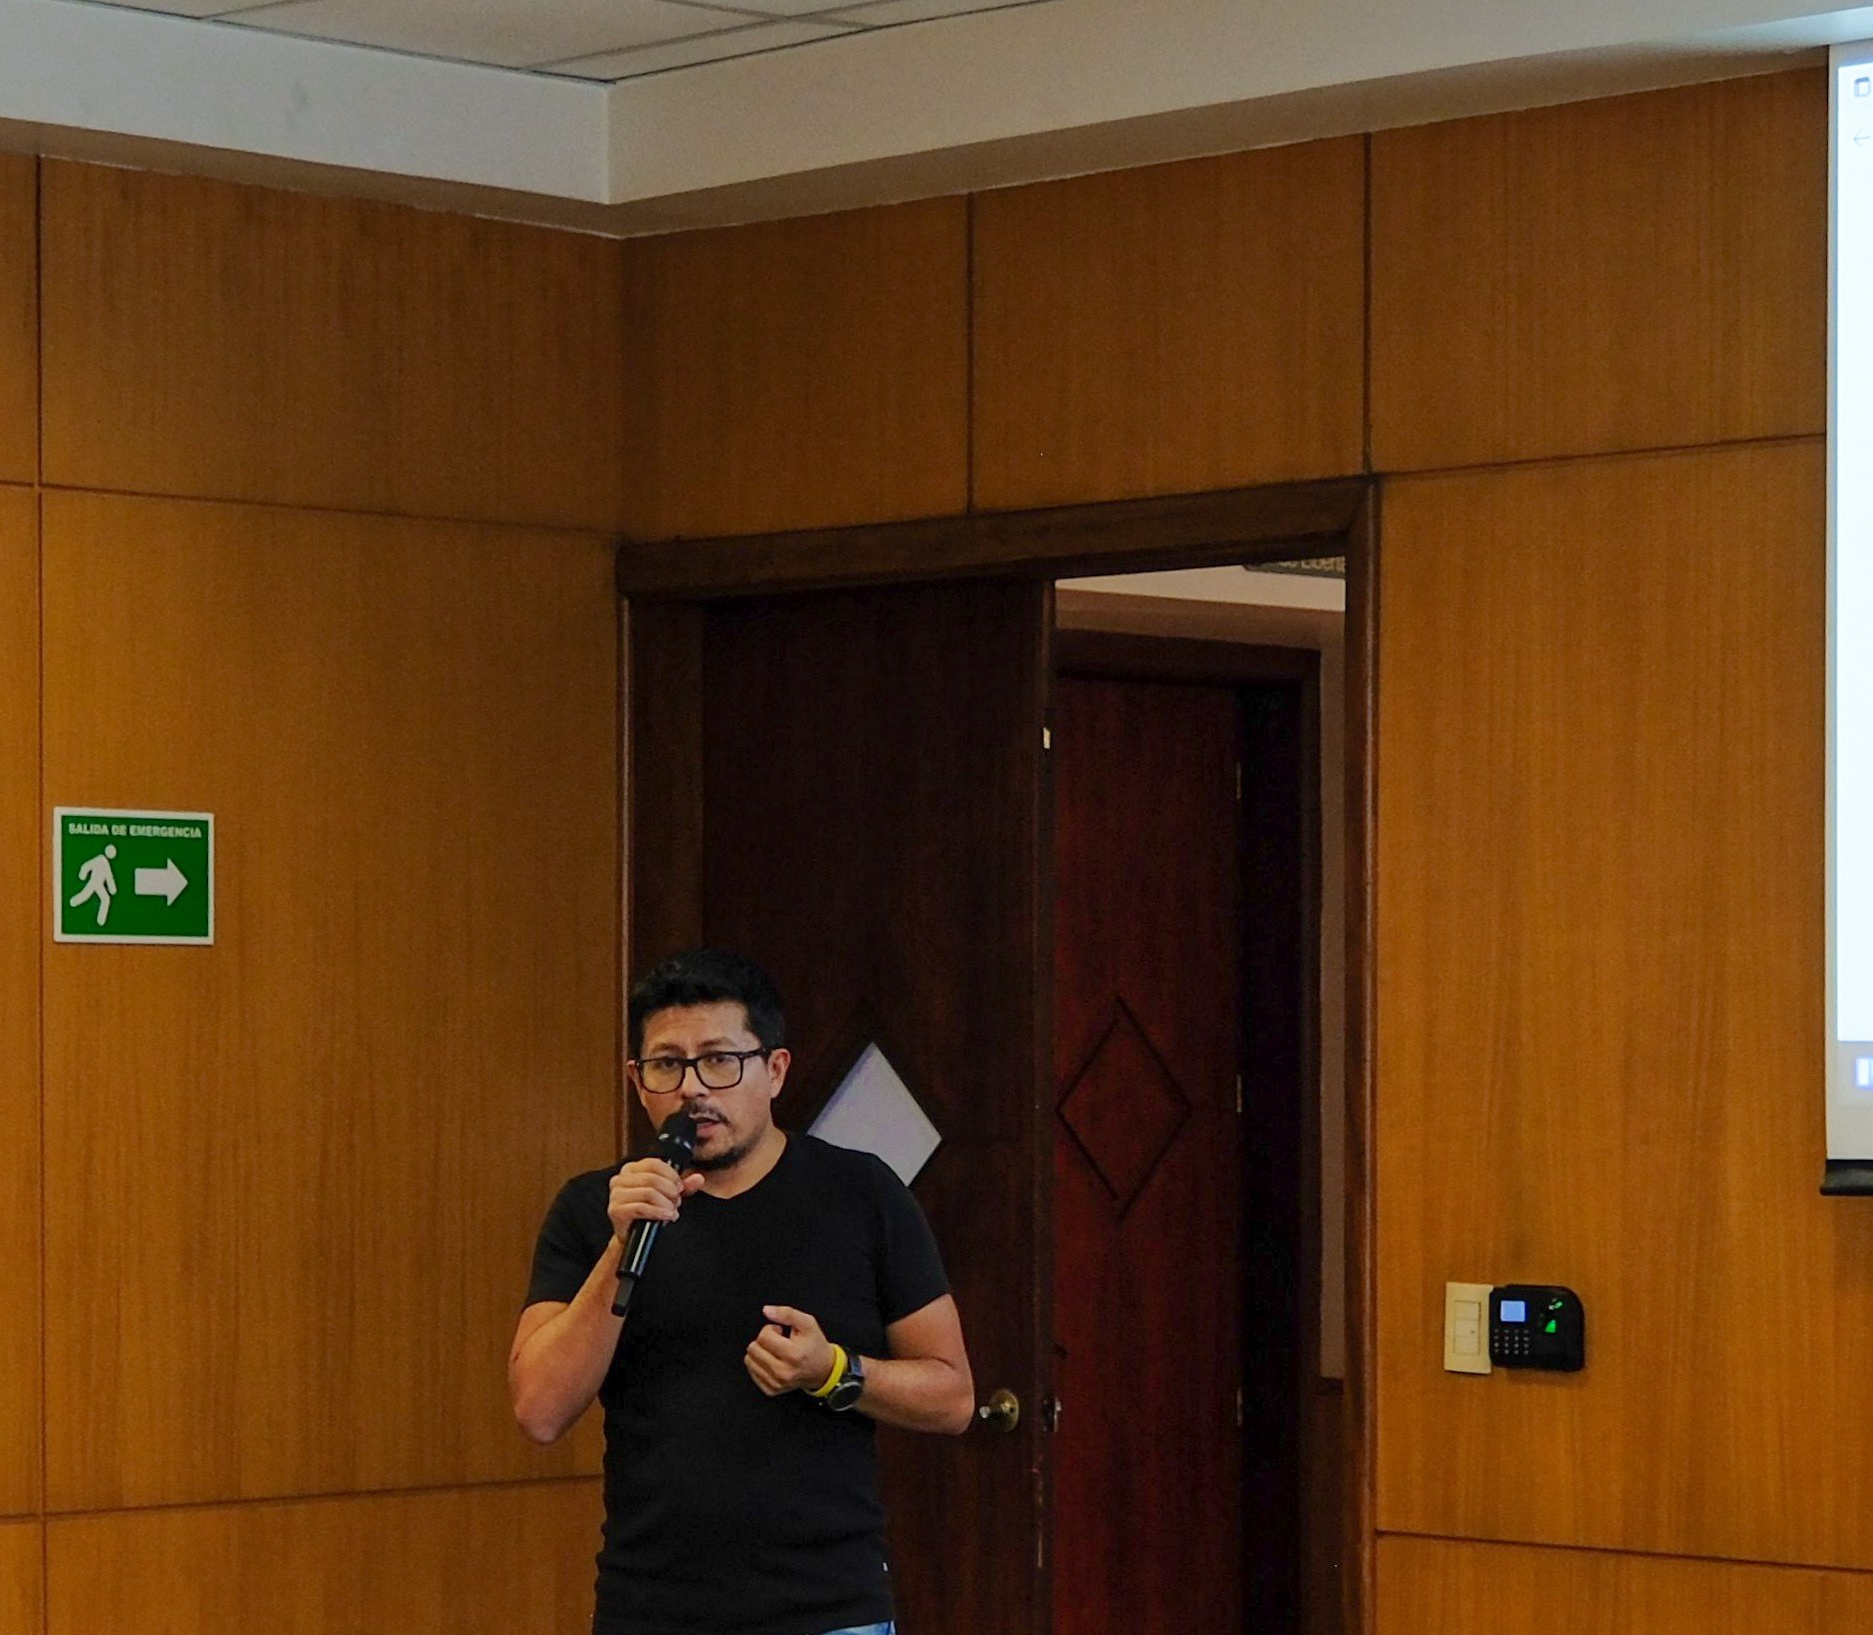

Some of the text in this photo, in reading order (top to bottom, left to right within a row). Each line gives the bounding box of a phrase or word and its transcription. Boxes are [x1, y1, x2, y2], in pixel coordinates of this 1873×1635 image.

[68, 823, 202, 838] SALIDA DE EMERGENCIA
